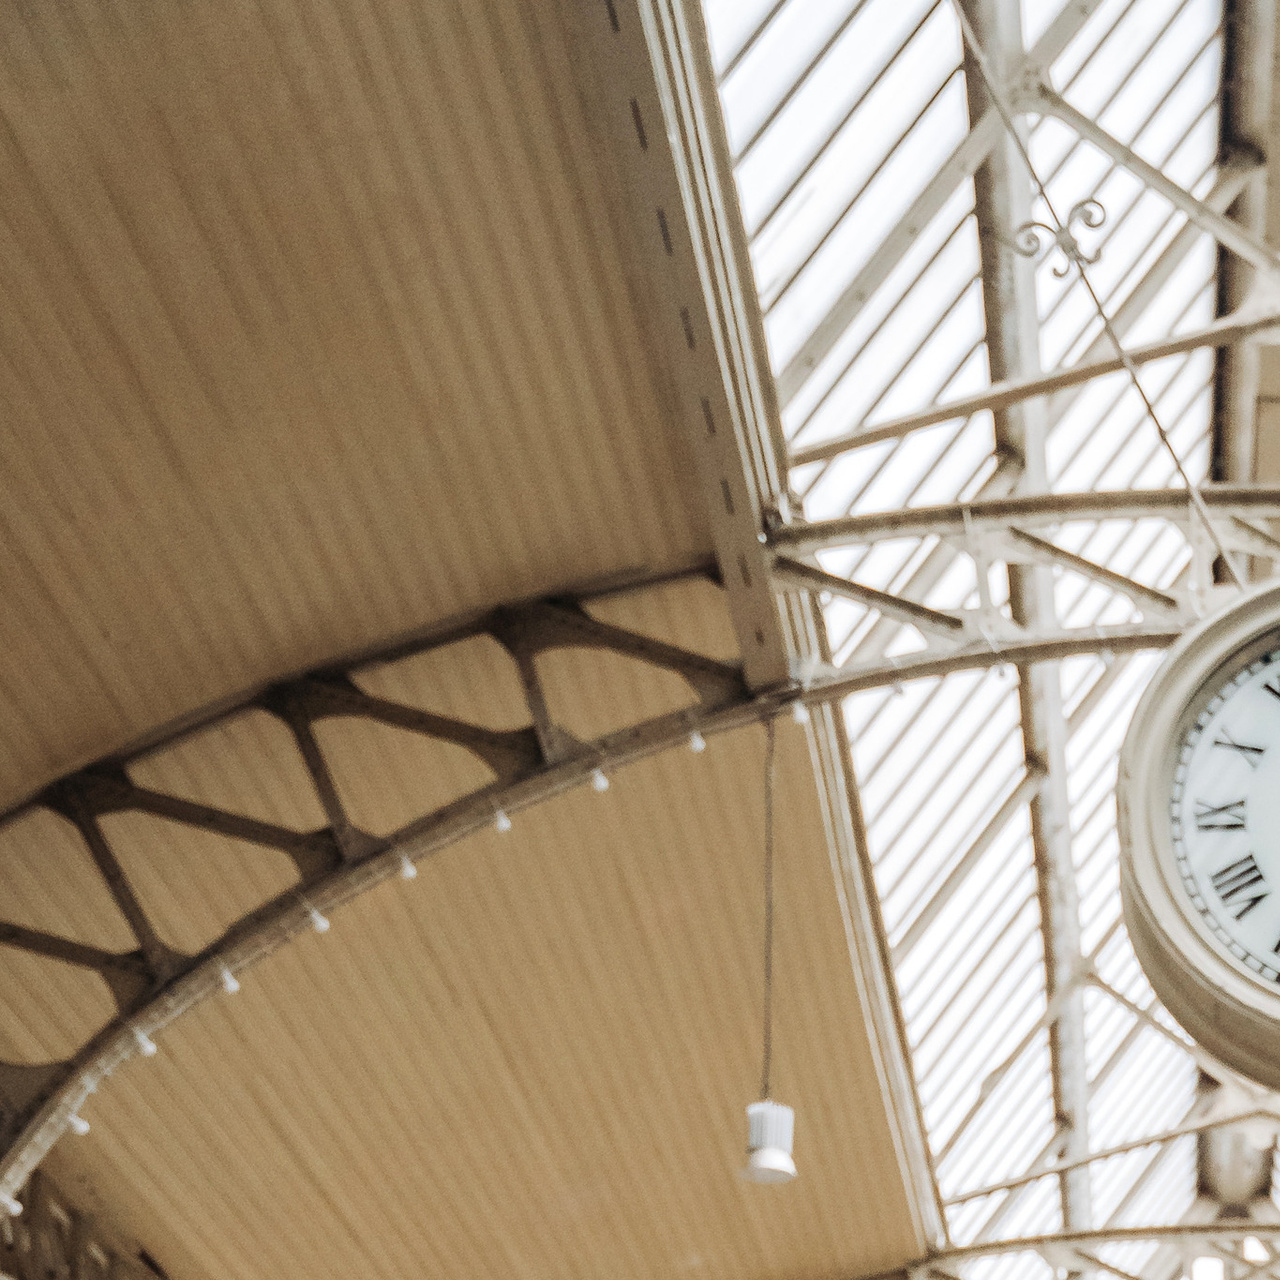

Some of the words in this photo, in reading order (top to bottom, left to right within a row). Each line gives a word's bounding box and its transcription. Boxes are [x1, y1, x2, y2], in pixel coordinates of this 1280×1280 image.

[1213, 726, 1265, 768] X
[1195, 799, 1246, 831] IX
[1210, 853, 1269, 920] VIII
